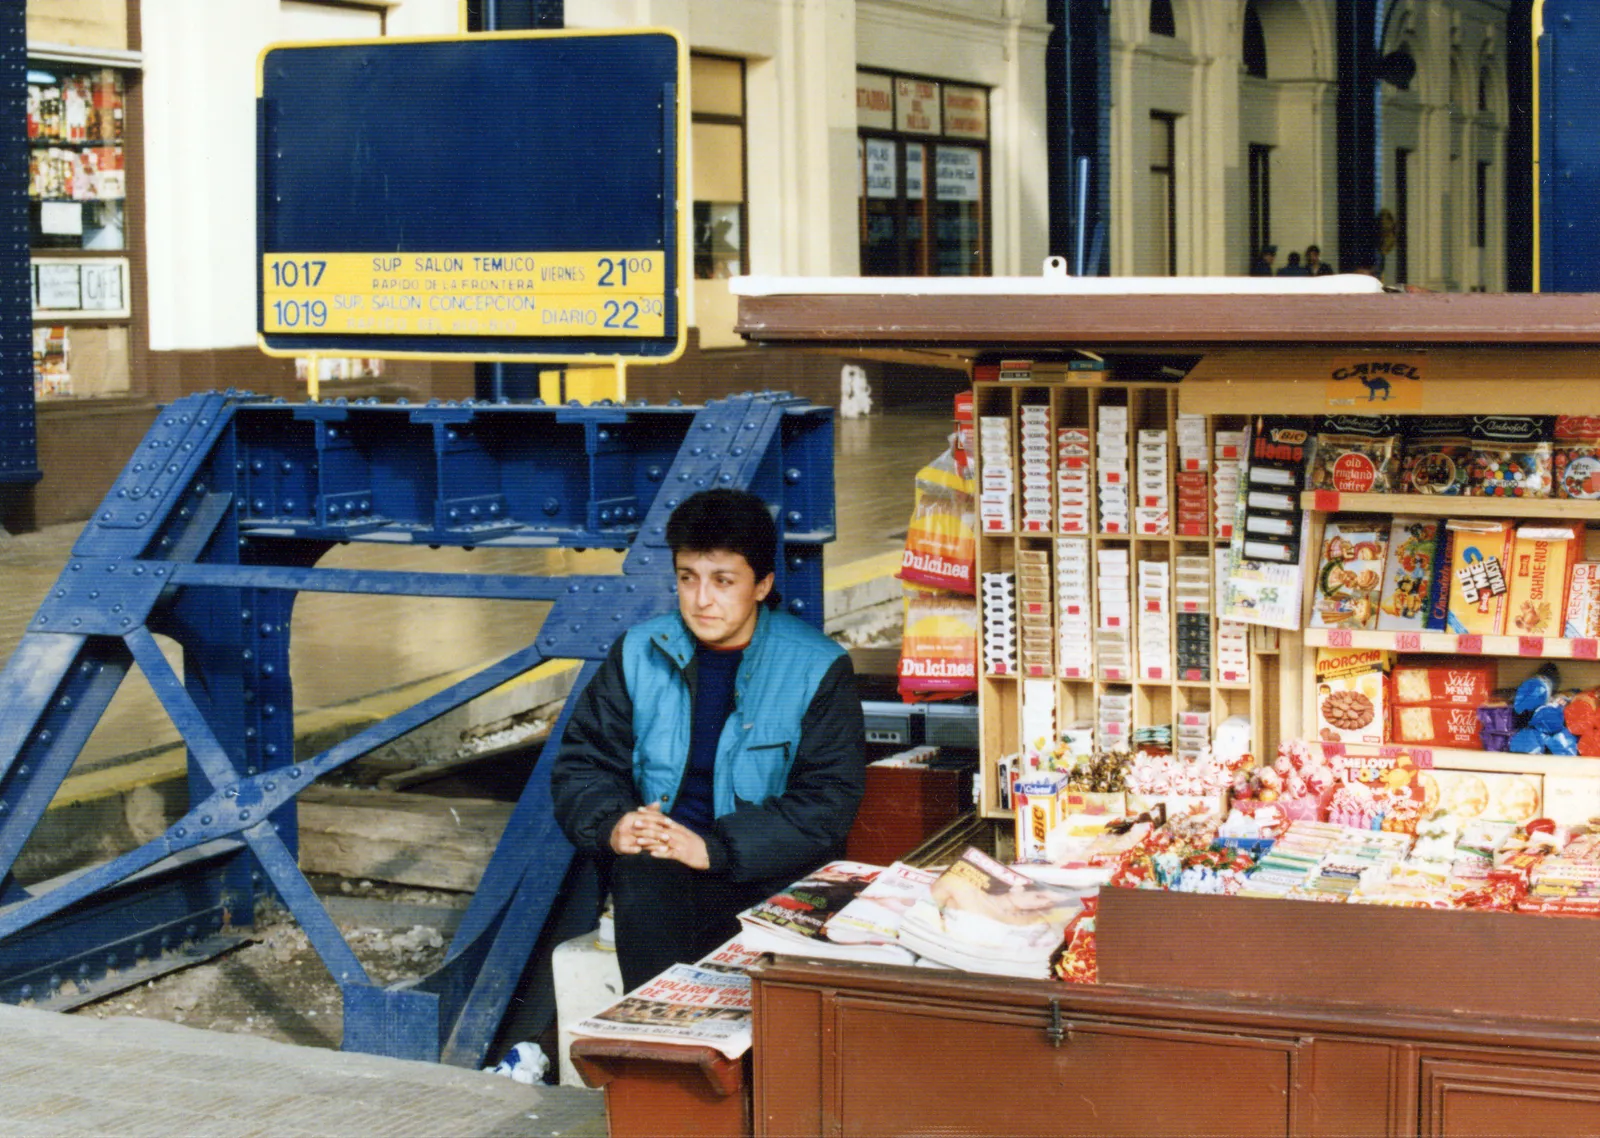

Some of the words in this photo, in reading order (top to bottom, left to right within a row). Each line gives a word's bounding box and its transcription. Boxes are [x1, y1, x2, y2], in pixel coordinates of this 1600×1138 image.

[271, 260, 327, 287] 1017
[372, 257, 402, 272] SUP
[415, 257, 464, 272] SALON
[473, 257, 535, 272] TEMUCO
[541, 266, 585, 282] VIERNES
[372, 279, 419, 290] RAPIDO
[425, 279, 437, 290] DE
[443, 279, 457, 290] LA
[462, 279, 535, 291] FRONTERA
[273, 300, 328, 327] 1019
[371, 295, 421, 311] SALON
[429, 295, 535, 311] CONCEPCION
[541, 309, 597, 326] DIARIO
[1331, 362, 1421, 381] CAMEL
[1280, 430, 1305, 442] BIC
[1344, 457, 1362, 468] old
[902, 549, 970, 579] Dulcinea
[1470, 561, 1491, 589] ME
[1568, 567, 1586, 620] TRENCITO
[901, 658, 975, 677] Dulcinea
[1319, 650, 1381, 671] MOROCHA
[1444, 671, 1477, 687] Soda
[1447, 709, 1477, 726] Soda
[1343, 757, 1396, 769] MELODY
[1033, 806, 1045, 843] BIC
[637, 987, 664, 998] DE
[665, 993, 708, 1003] ALTA
[652, 979, 718, 994] VOLARON
